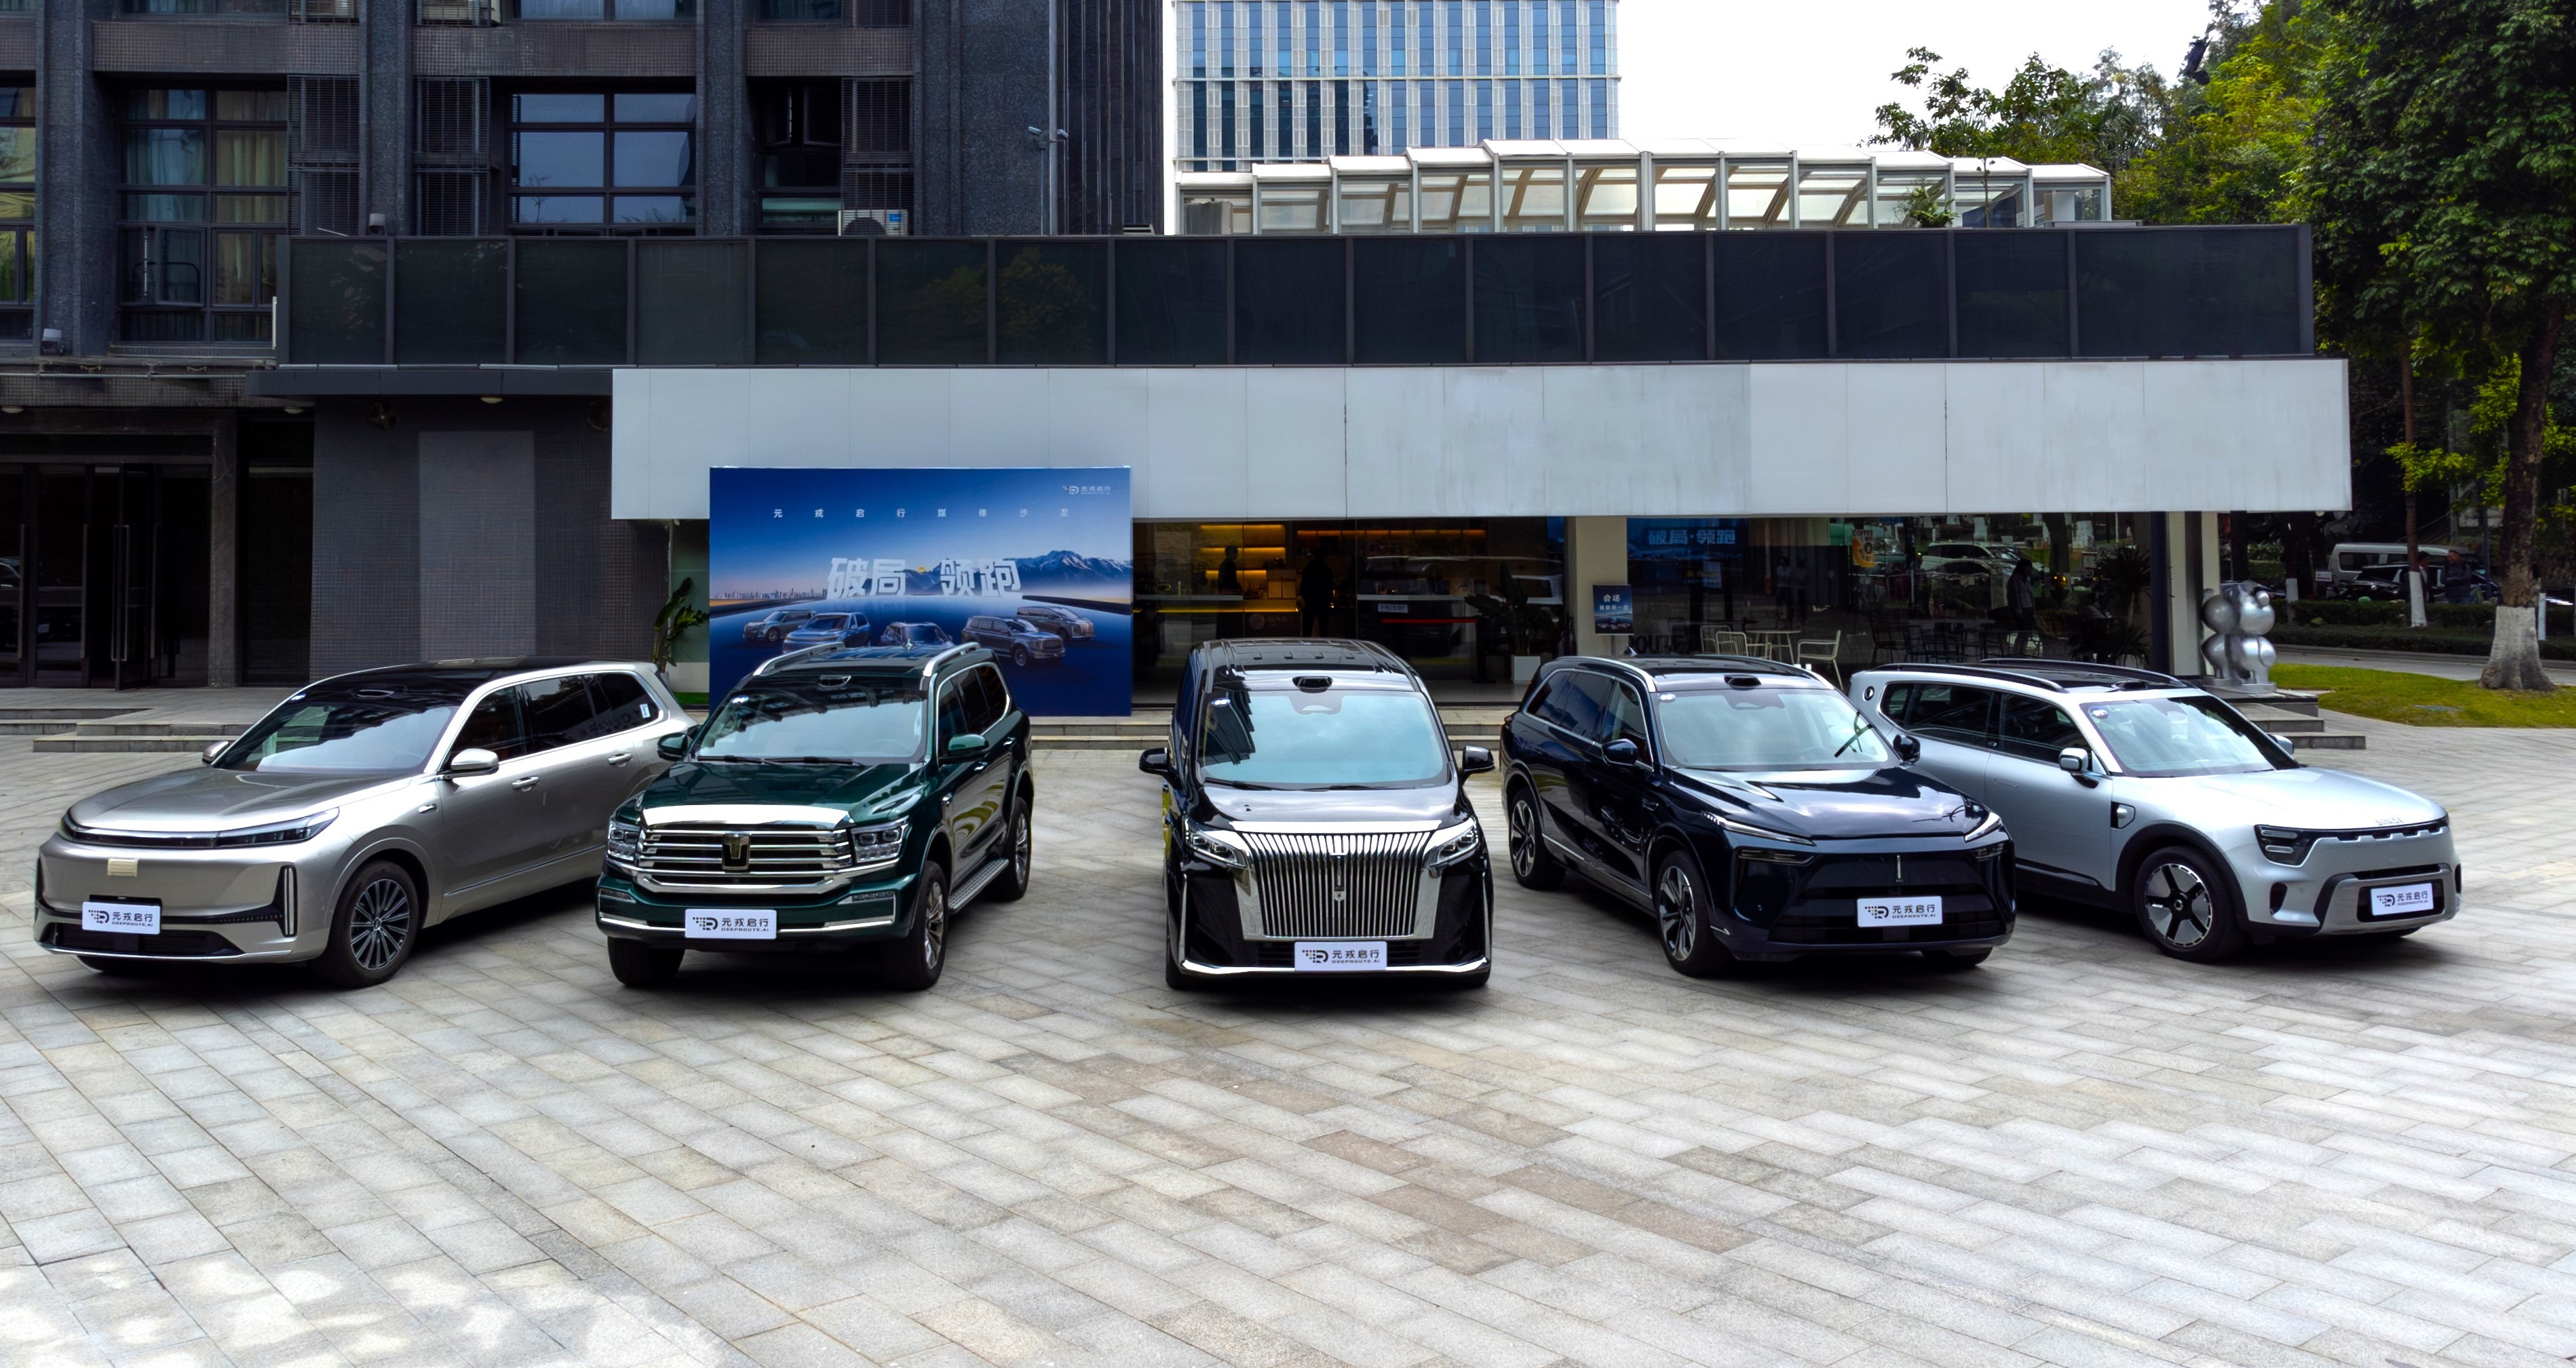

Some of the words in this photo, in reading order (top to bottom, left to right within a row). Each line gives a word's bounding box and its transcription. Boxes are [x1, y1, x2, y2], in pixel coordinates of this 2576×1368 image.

[826, 557, 906, 599] 破局
[940, 557, 1022, 599] 领跑
[2397, 891, 2428, 901] 元戎启行
[1892, 904, 1936, 914] 元戎启行
[112, 912, 153, 923] 元戎启行
[721, 918, 769, 927] 元戎启行
[1332, 950, 1379, 959] 元戎启行
